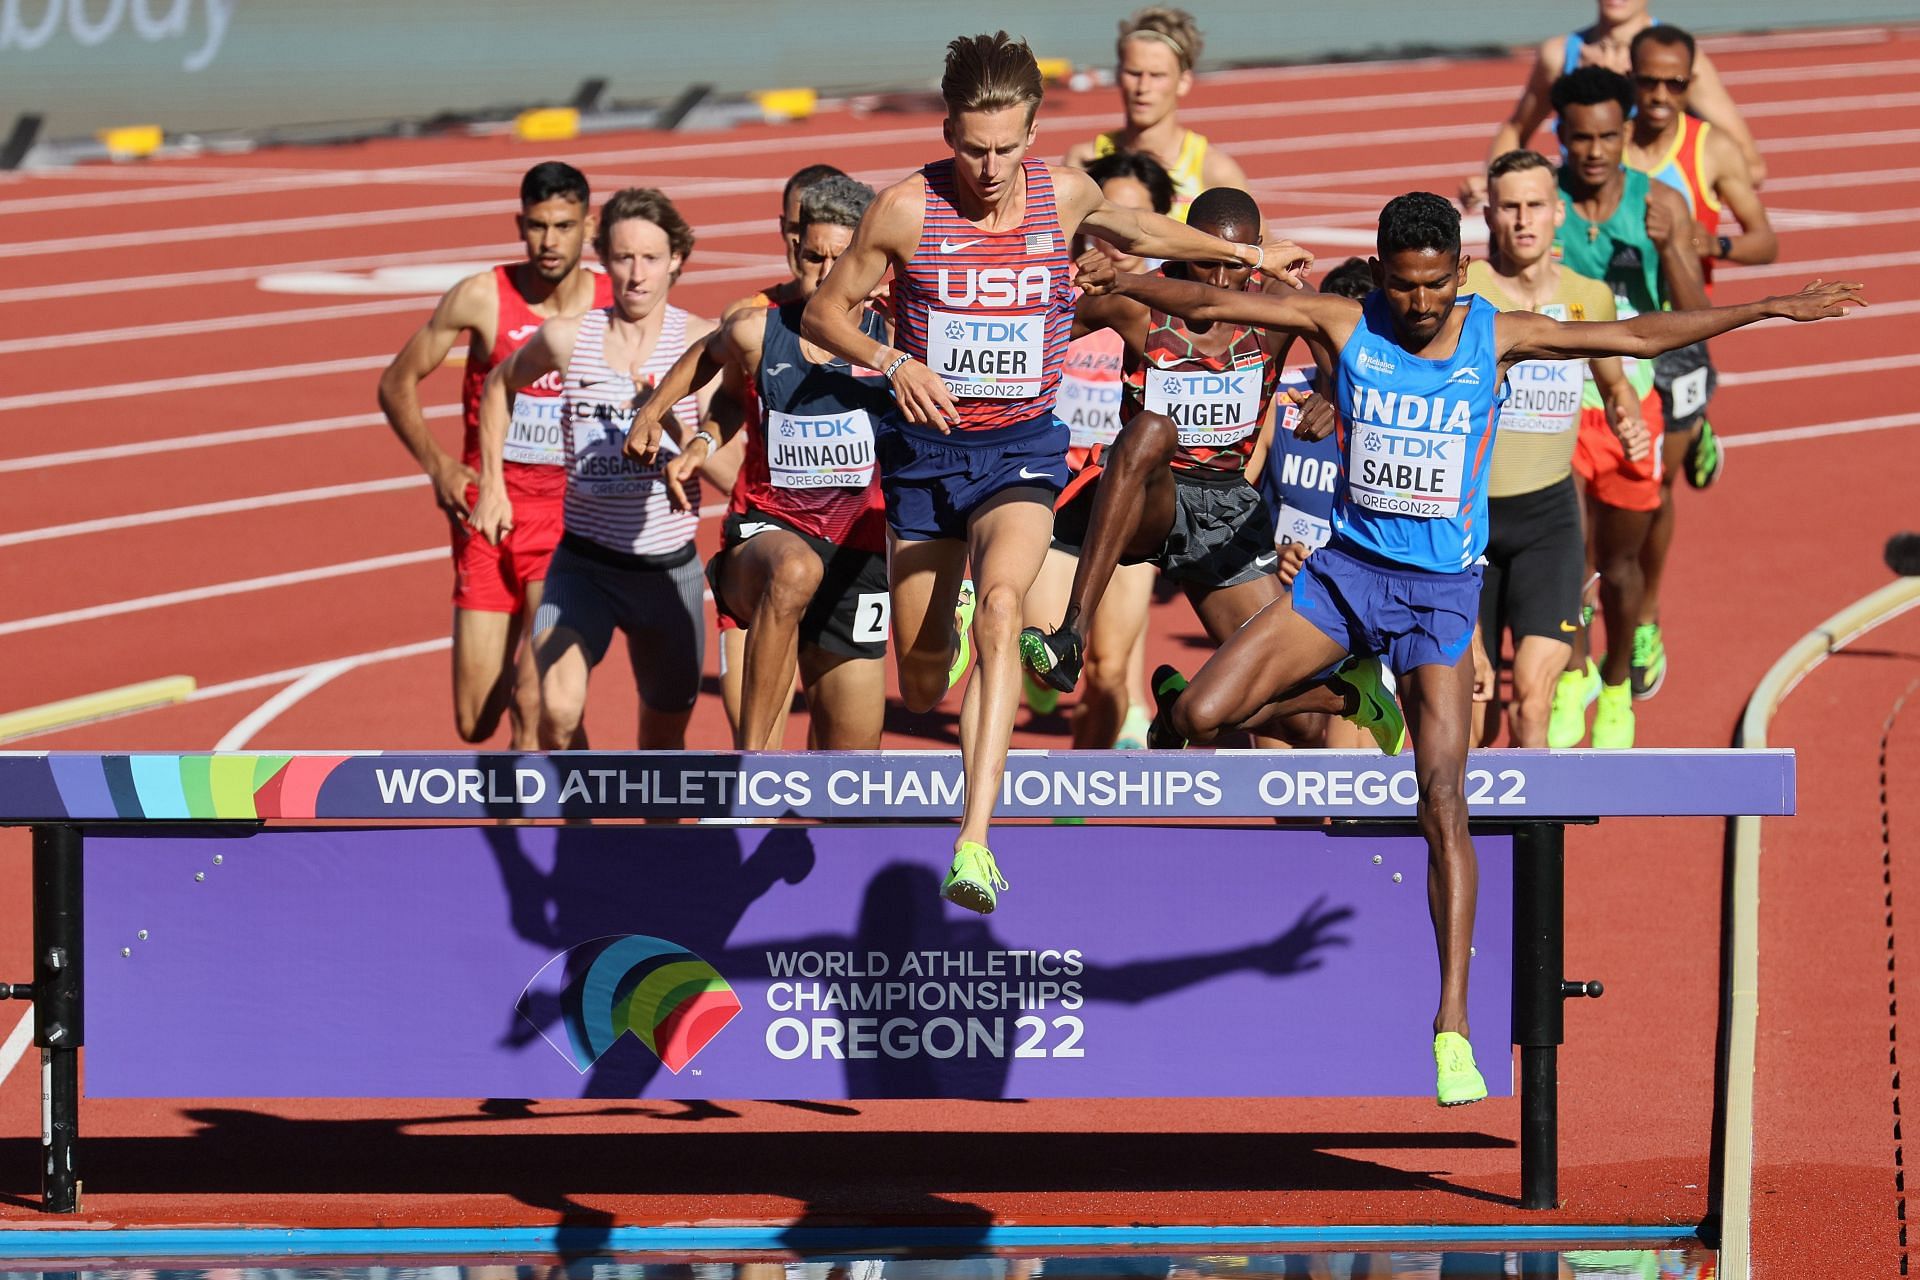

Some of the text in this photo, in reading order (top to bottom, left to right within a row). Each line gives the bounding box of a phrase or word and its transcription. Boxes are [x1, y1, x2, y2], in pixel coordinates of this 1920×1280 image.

[938, 266, 1051, 307] USA
[965, 322, 1029, 342] TDK
[944, 348, 1027, 375] JAGER
[1516, 364, 1568, 382] TDK
[945, 381, 1024, 397] OREGON22
[1183, 376, 1246, 395] TDK
[1167, 402, 1241, 426] KIGEN
[1352, 385, 1472, 434] INDIA
[794, 417, 857, 438] TDK
[774, 440, 871, 467] JHINAOUI
[1382, 434, 1449, 460] TDK
[786, 474, 862, 486] OREGON22
[1281, 453, 1338, 492] NOR
[1362, 459, 1446, 492] SABLE
[1362, 494, 1441, 515] OREGON22
[868, 602, 883, 632] 2
[376, 768, 546, 804] WORLD
[558, 769, 812, 806] ATHLETICS
[827, 769, 1223, 806] CHAMIONSHIPS
[766, 950, 1084, 977] WORLD ATHLETICS
[766, 980, 1084, 1012] CHAMPIONSHIPS
